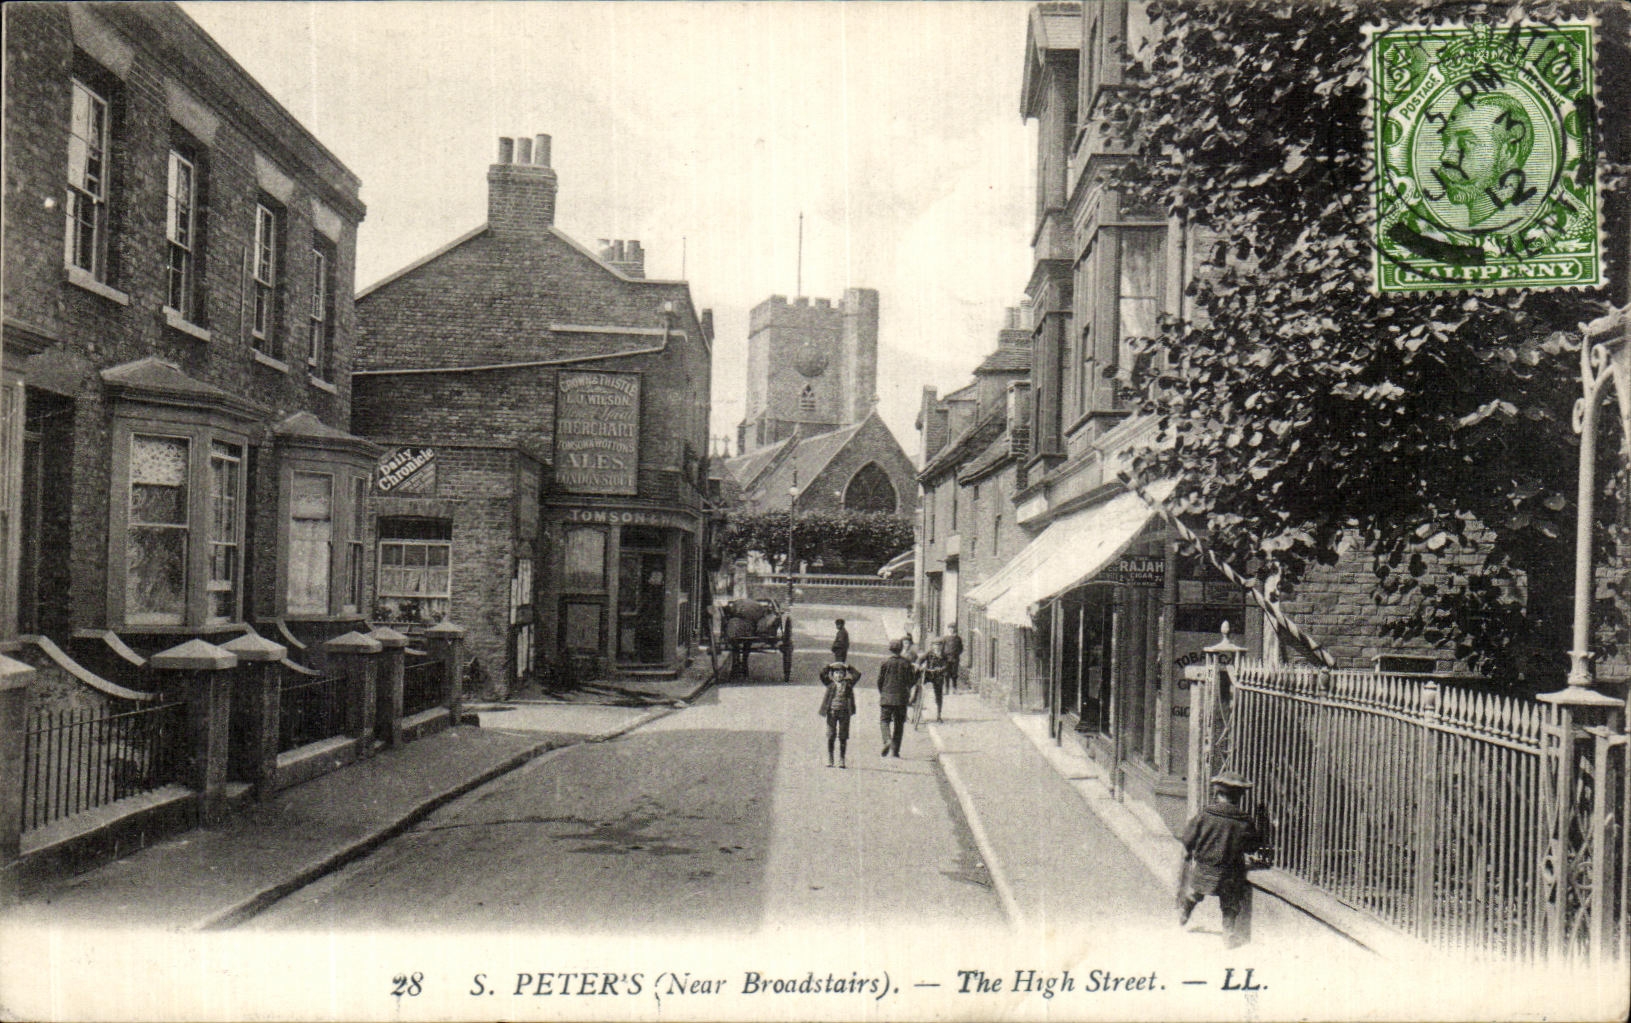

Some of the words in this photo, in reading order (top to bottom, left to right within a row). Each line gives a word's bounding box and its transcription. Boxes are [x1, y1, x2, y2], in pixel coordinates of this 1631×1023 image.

[1399, 73, 1441, 121] POSTAGE
[1403, 262, 1574, 283] HALFPENNY
[558, 420, 635, 437] MERCHANT
[379, 448, 434, 491] Chronicle
[380, 448, 412, 475] Daily
[568, 509, 646, 523] TOMSON
[1119, 560, 1164, 573] RAJAH
